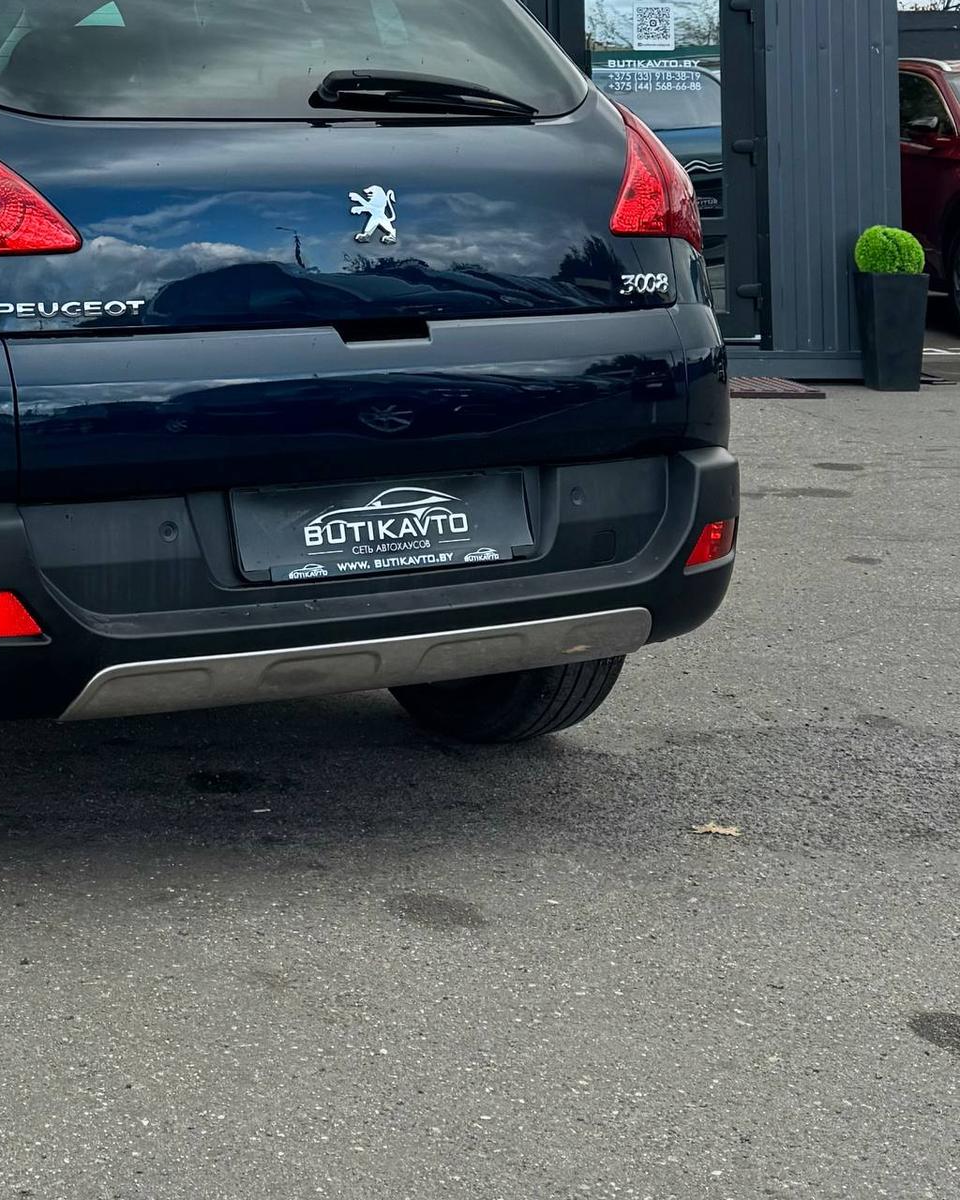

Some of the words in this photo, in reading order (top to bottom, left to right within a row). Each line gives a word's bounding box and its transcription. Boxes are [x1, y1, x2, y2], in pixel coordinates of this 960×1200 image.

[607, 59, 701, 69] BUTIKAVTO.BY
[608, 71, 632, 81] +375
[634, 71, 652, 83] (33)
[654, 71, 701, 81] 918-38-19
[608, 81, 632, 91] +375
[634, 81, 652, 93] (44)
[655, 82, 702, 92] 568-66-88
[620, 273, 669, 295] 3008
[304, 513, 469, 547] BUTIKAVTO
[352, 545, 374, 555] СЕТЬ
[375, 540, 431, 553] АВТОХАУСОВ
[337, 560, 371, 572] WWW.
[374, 552, 454, 569] BUTIKAVTO.BY
